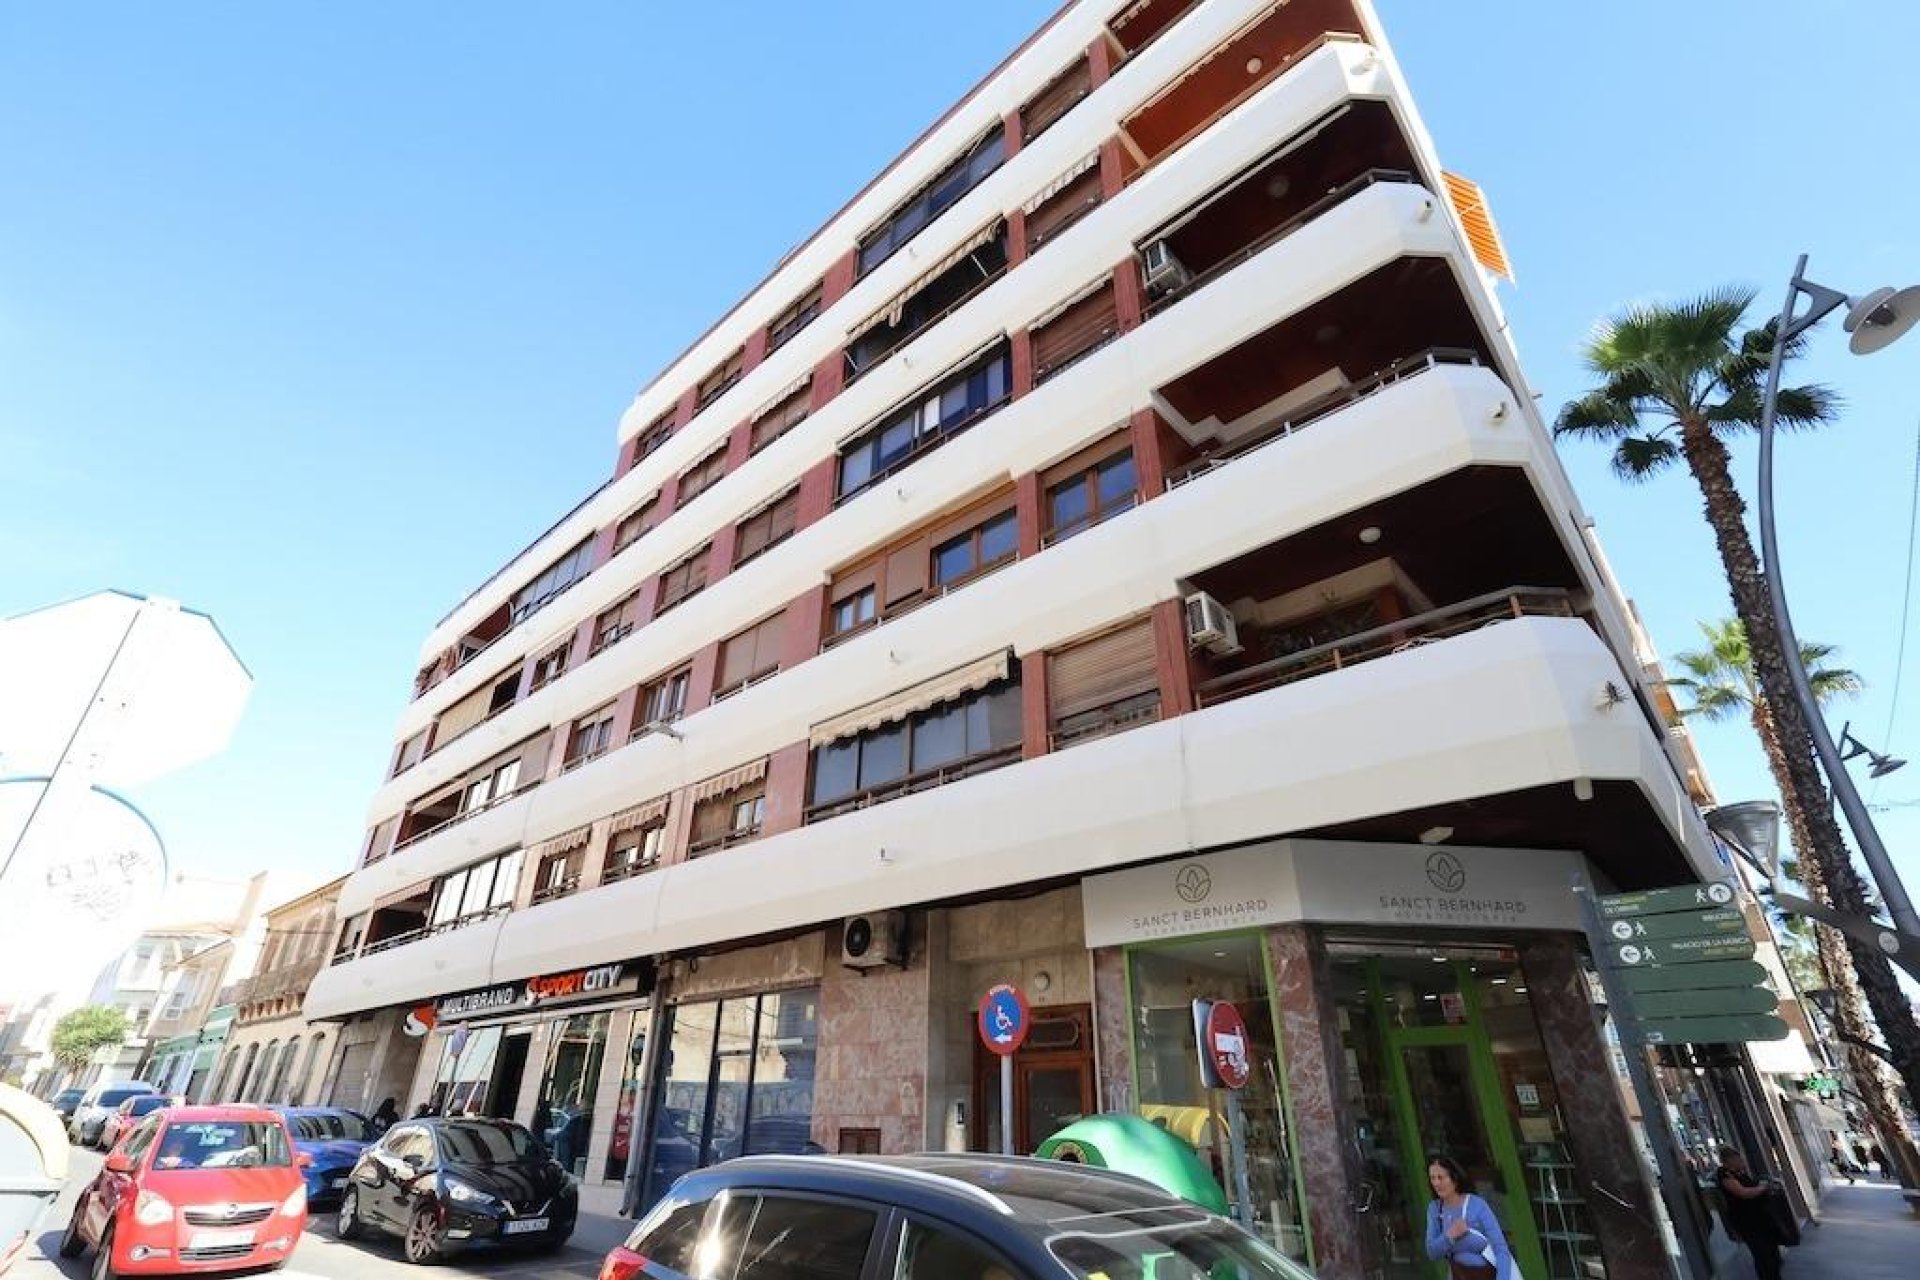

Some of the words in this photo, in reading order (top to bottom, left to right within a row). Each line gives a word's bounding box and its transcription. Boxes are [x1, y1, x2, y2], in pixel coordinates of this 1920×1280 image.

[1132, 910, 1178, 929] SANCT
[1184, 899, 1268, 922] BERNHARD
[1379, 895, 1432, 909] SANCT
[1439, 897, 1527, 914] BERNHARD
[442, 987, 514, 1014] MULTIBRAND
